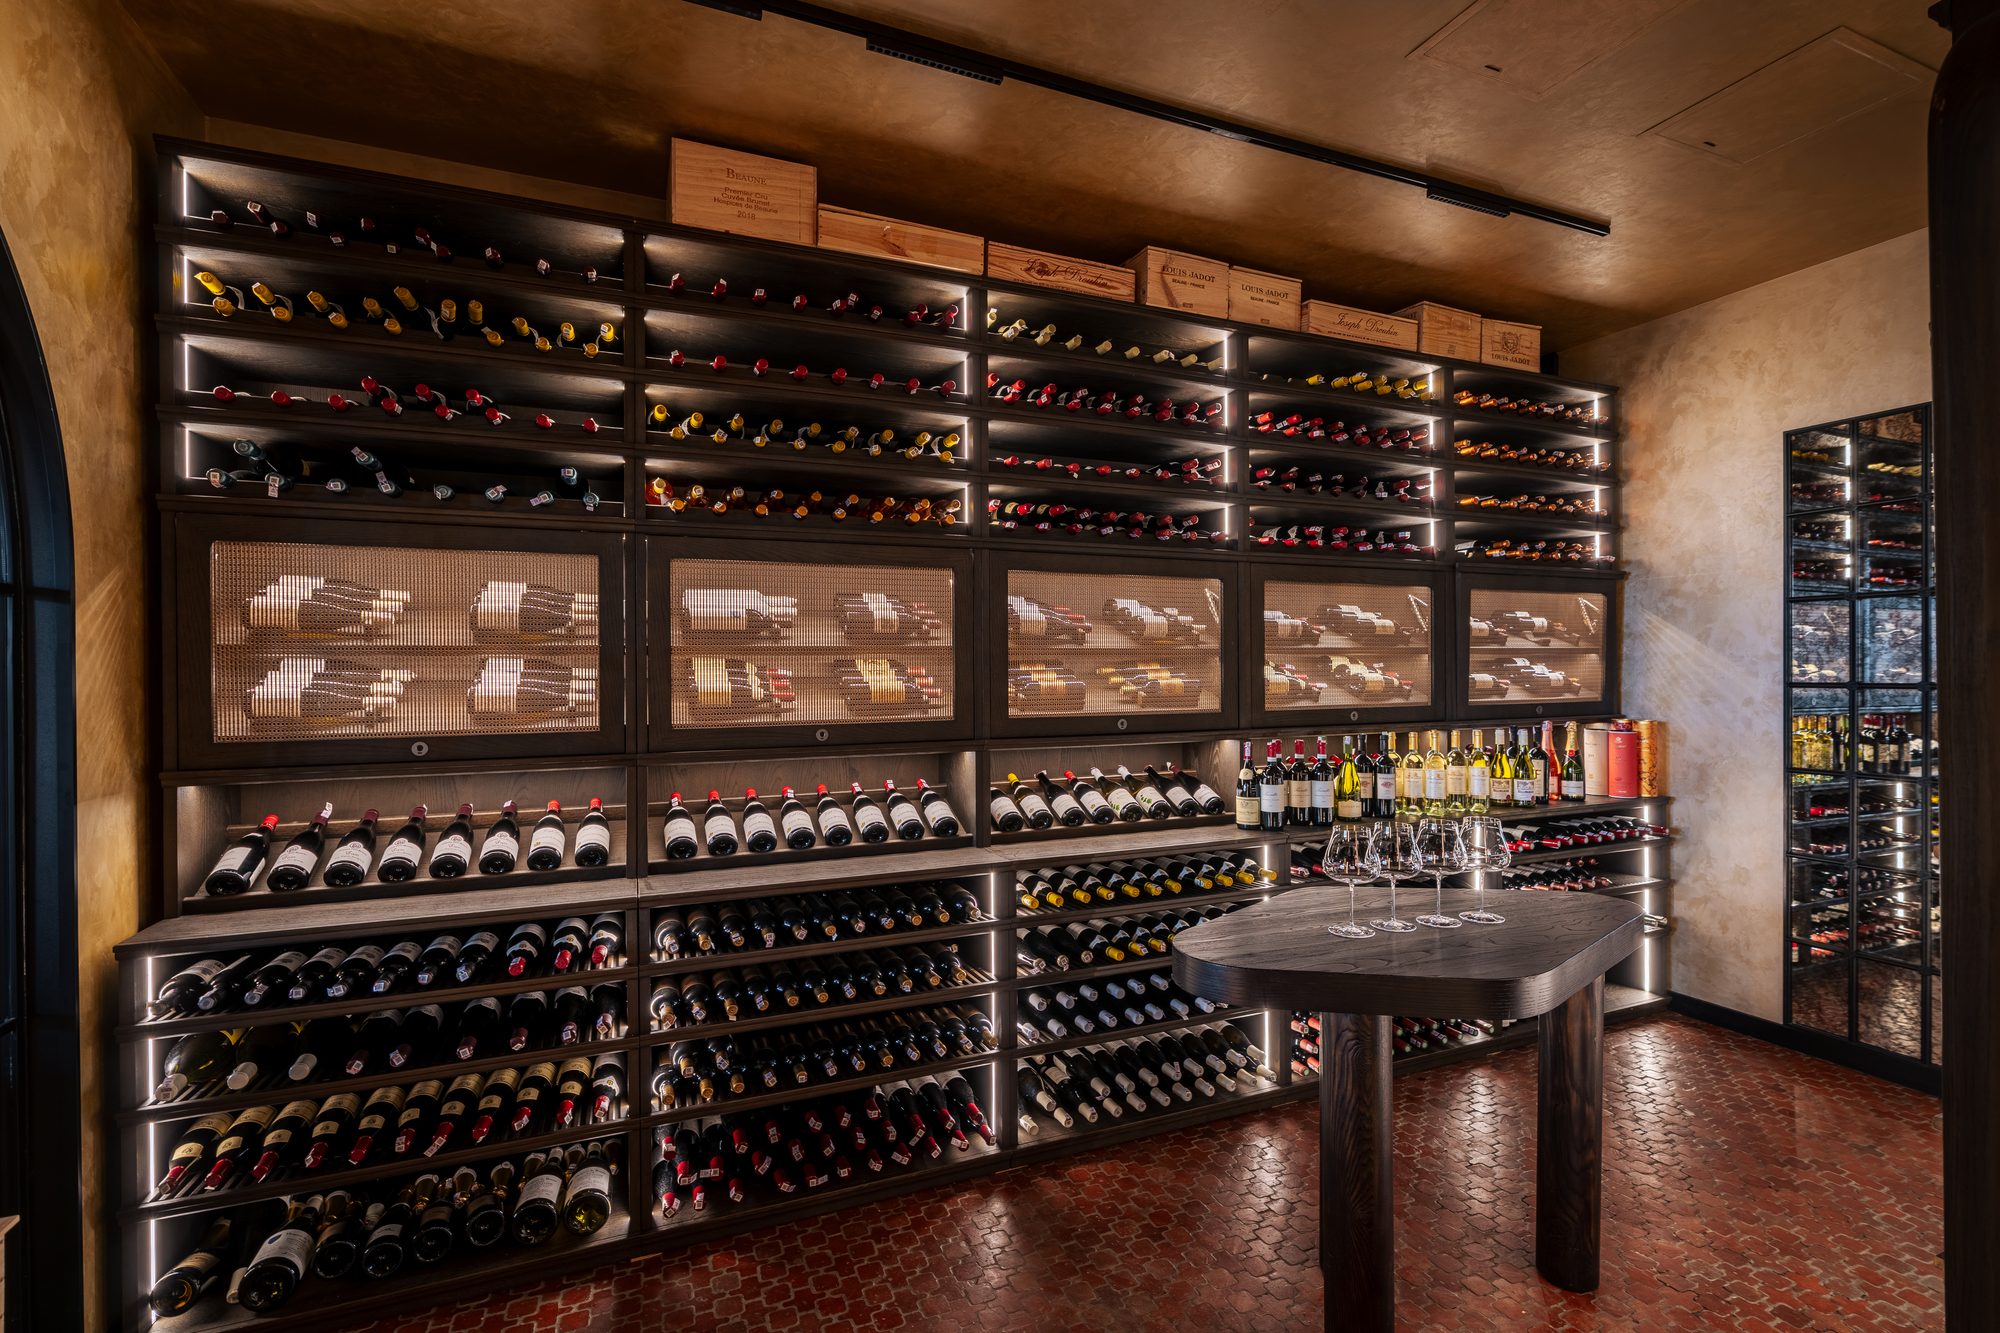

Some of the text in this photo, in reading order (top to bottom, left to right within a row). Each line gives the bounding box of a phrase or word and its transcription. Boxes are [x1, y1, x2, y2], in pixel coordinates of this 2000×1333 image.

[726, 167, 768, 185] BEAUNE
[724, 186, 768, 200] Premier Cru
[737, 210, 756, 221] 2018
[754, 204, 778, 214] Beaune
[1162, 265, 1215, 283] LOUIS JADOT
[1241, 283, 1289, 300] LOUIS JADOT
[1332, 312, 1399, 337] Joseph Drouhin
[1491, 353, 1531, 366] LOUIS JADOT
